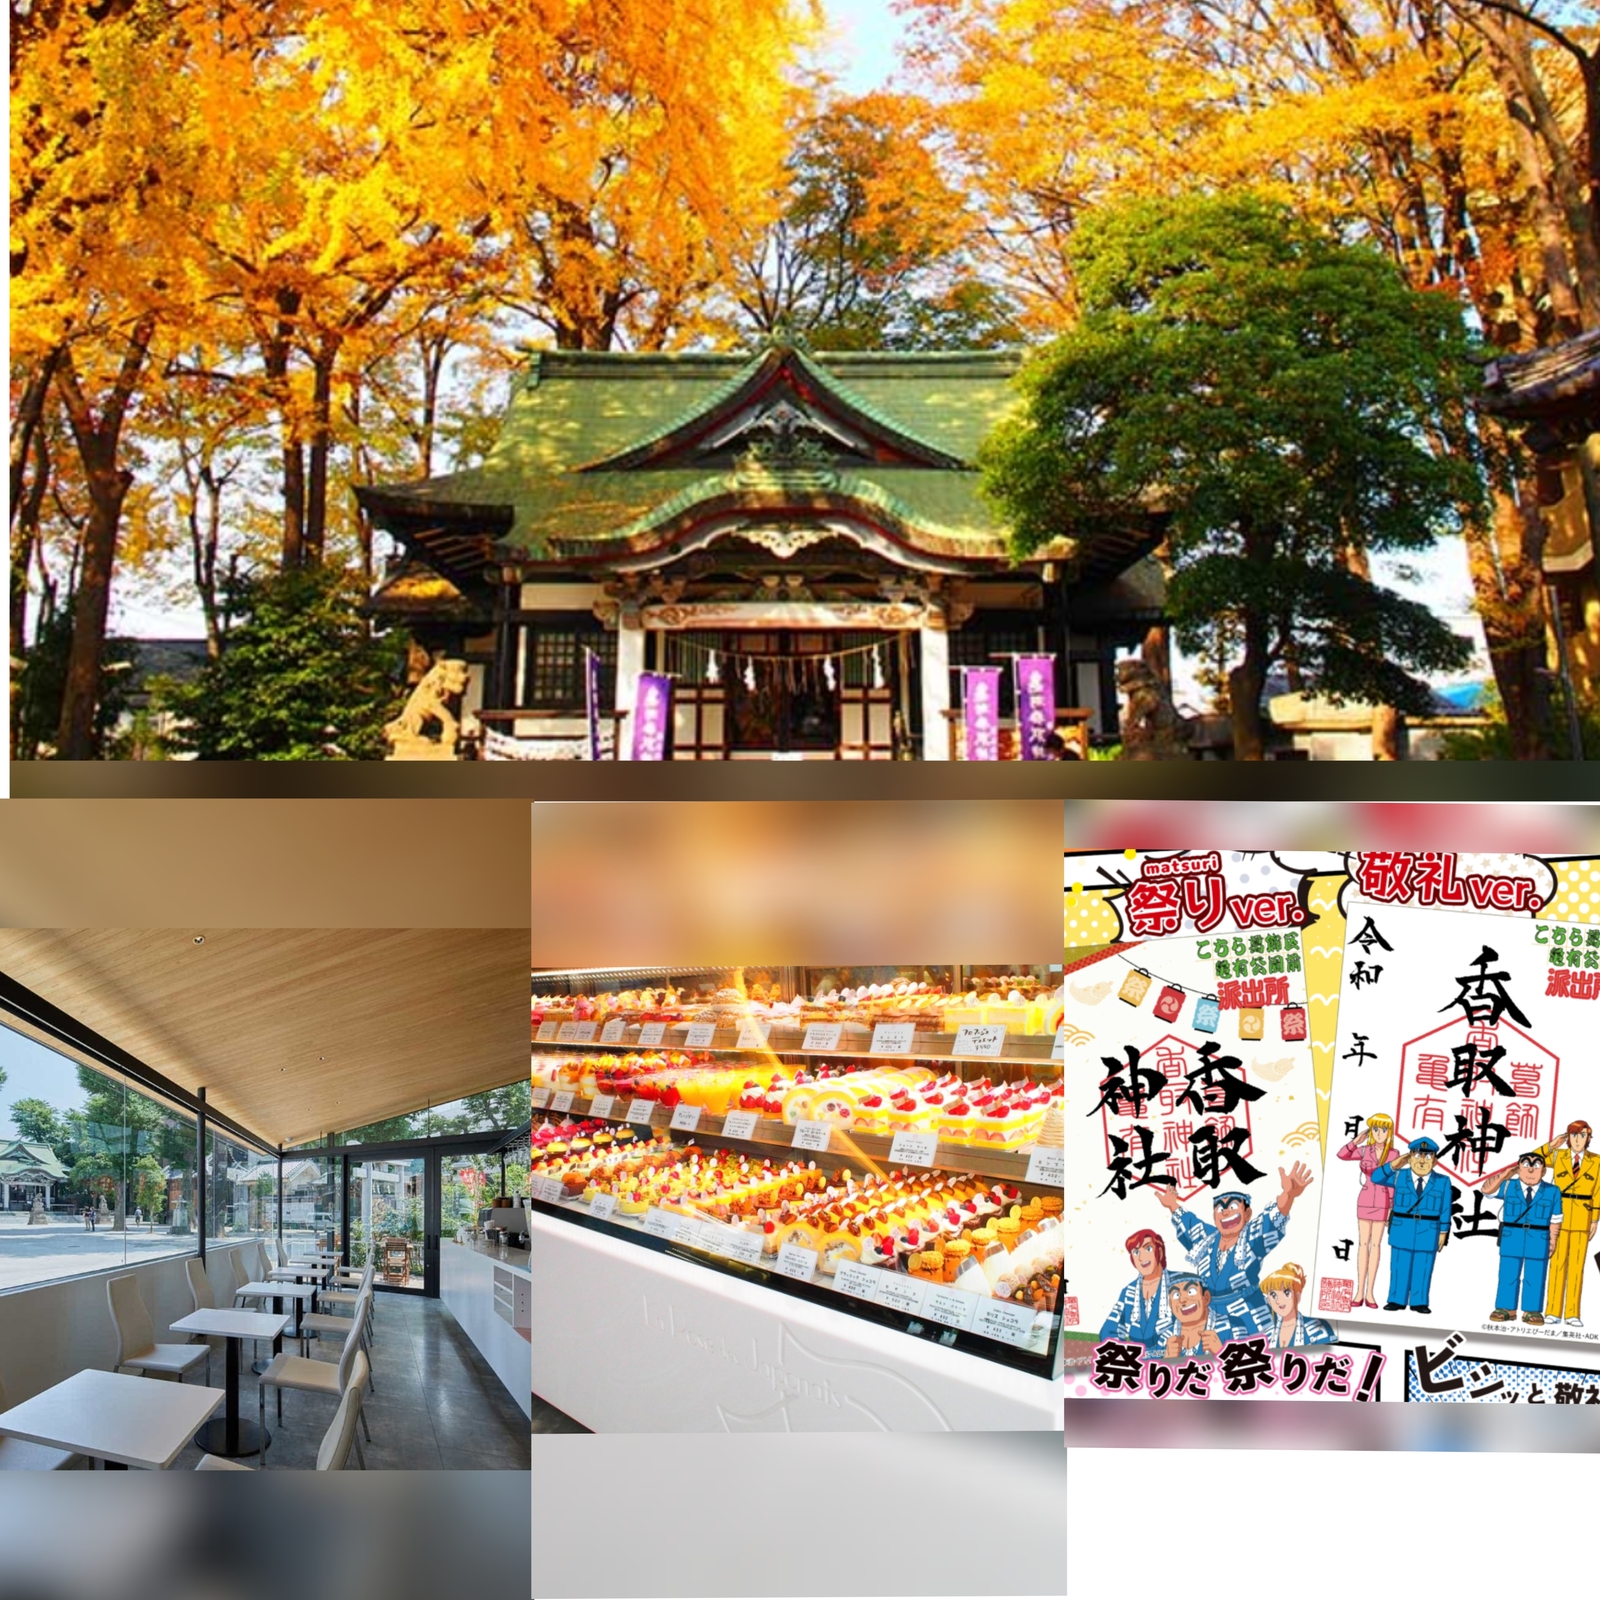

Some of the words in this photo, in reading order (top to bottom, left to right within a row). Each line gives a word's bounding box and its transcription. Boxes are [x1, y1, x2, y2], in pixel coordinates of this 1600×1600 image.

[1144, 853, 1220, 877] matsuri
[1347, 915, 1395, 990] 令和
[1122, 975, 1147, 1002] 祭
[1217, 976, 1290, 1011] 派出所
[1195, 1003, 1219, 1027] 祭
[1283, 1012, 1305, 1036] 祭
[1342, 1032, 1378, 1068] 年
